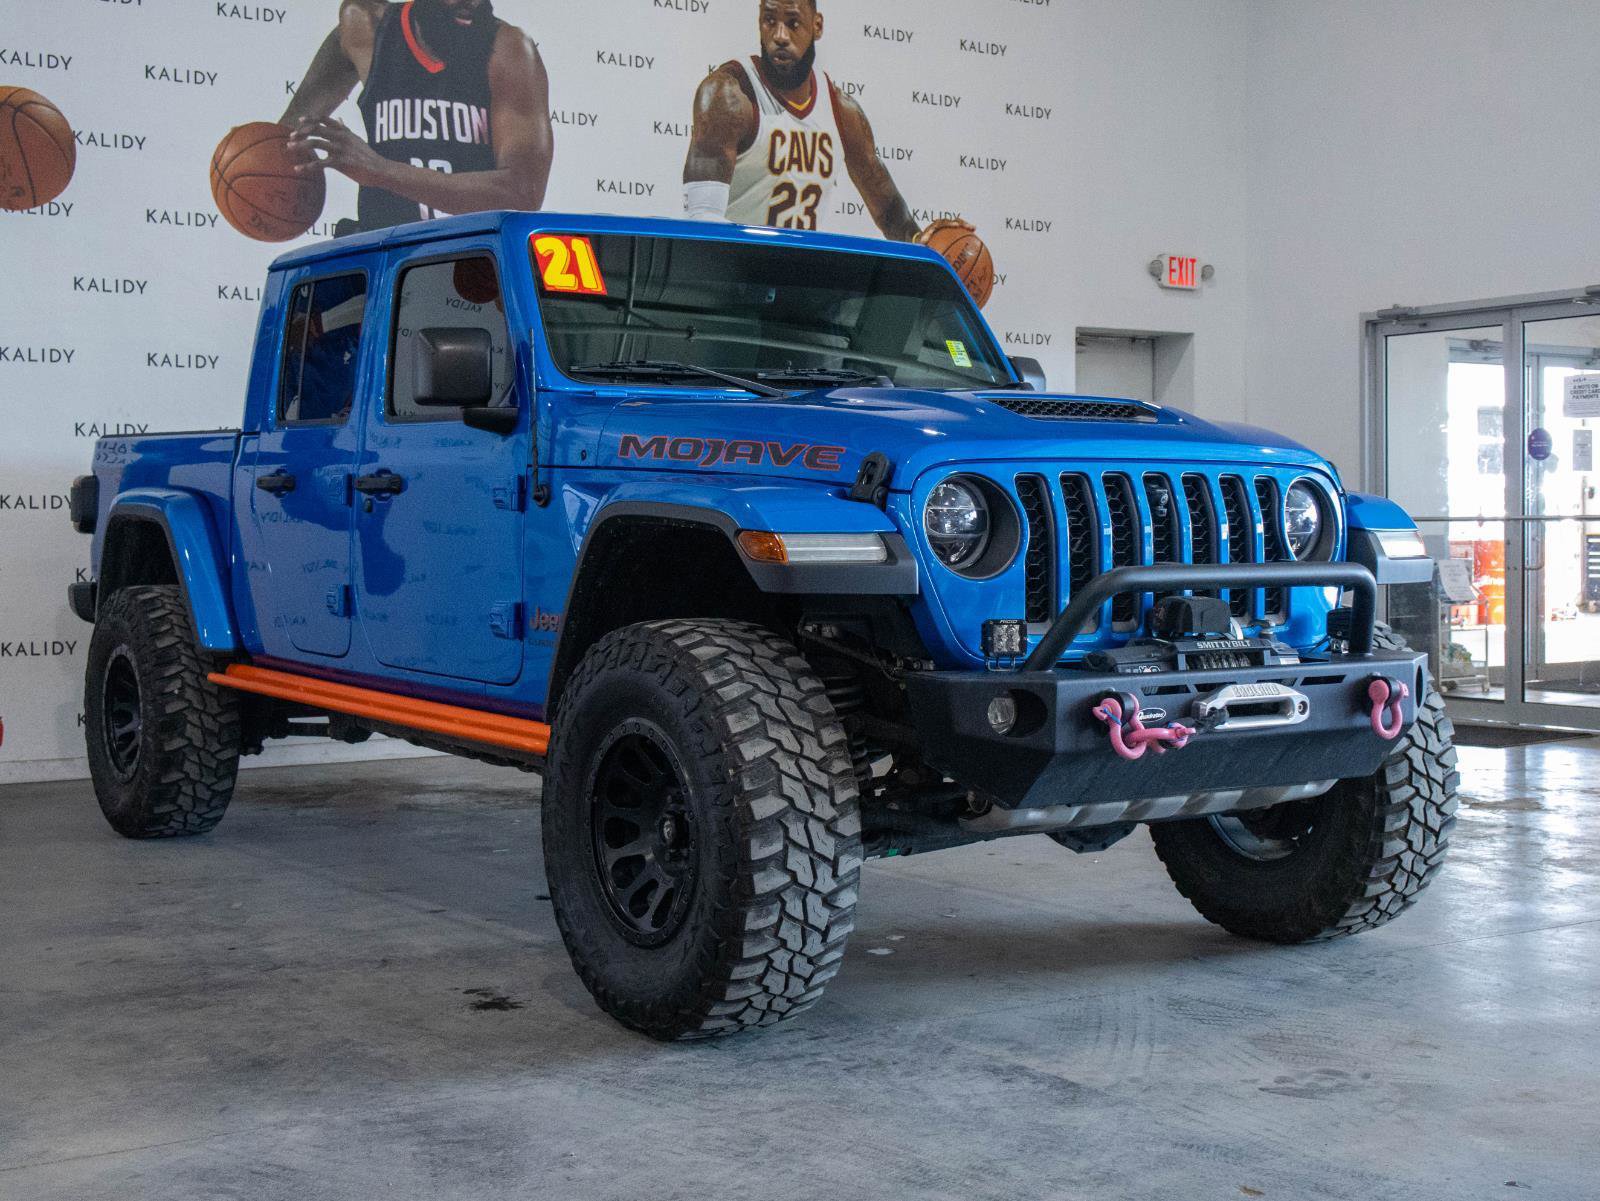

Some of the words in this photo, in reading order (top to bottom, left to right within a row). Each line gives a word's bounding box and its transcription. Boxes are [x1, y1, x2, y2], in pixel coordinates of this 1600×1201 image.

[217, 2, 287, 24] KALIDY
[864, 24, 914, 43] KALIDY
[960, 39, 1007, 56] KALIDY
[0, 49, 73, 71] KALIDY
[597, 50, 655, 70] KALIDY
[145, 64, 218, 86] KALIDY
[912, 91, 961, 108] KALIDY
[550, 109, 598, 127] ALIDY
[1006, 103, 1052, 119] KALIDY
[376, 98, 489, 145] HOUSTON
[654, 121, 693, 137] KALI
[72, 130, 146, 150] KALIDY
[768, 129, 833, 178] CAVS
[875, 147, 914, 161] ALIDY
[960, 155, 1007, 171] KALIDY
[597, 179, 655, 197] KALIDY
[767, 182, 822, 231] 23
[146, 209, 218, 228] KALIDY
[1006, 218, 1052, 232] KALIDY
[535, 235, 602, 291] 21
[1168, 256, 1197, 287] EXIT
[73, 276, 147, 295] KALIDY
[218, 285, 260, 301] KALI
[1006, 332, 1052, 346] KALIDY
[0, 348, 75, 364] KALIDY
[147, 353, 219, 369] KALIDY
[618, 434, 846, 472] MOJAVE
[530, 607, 561, 633] Jee
[1, 641, 77, 657] KALIDY
[1196, 640, 1251, 649] SMITTYBILT
